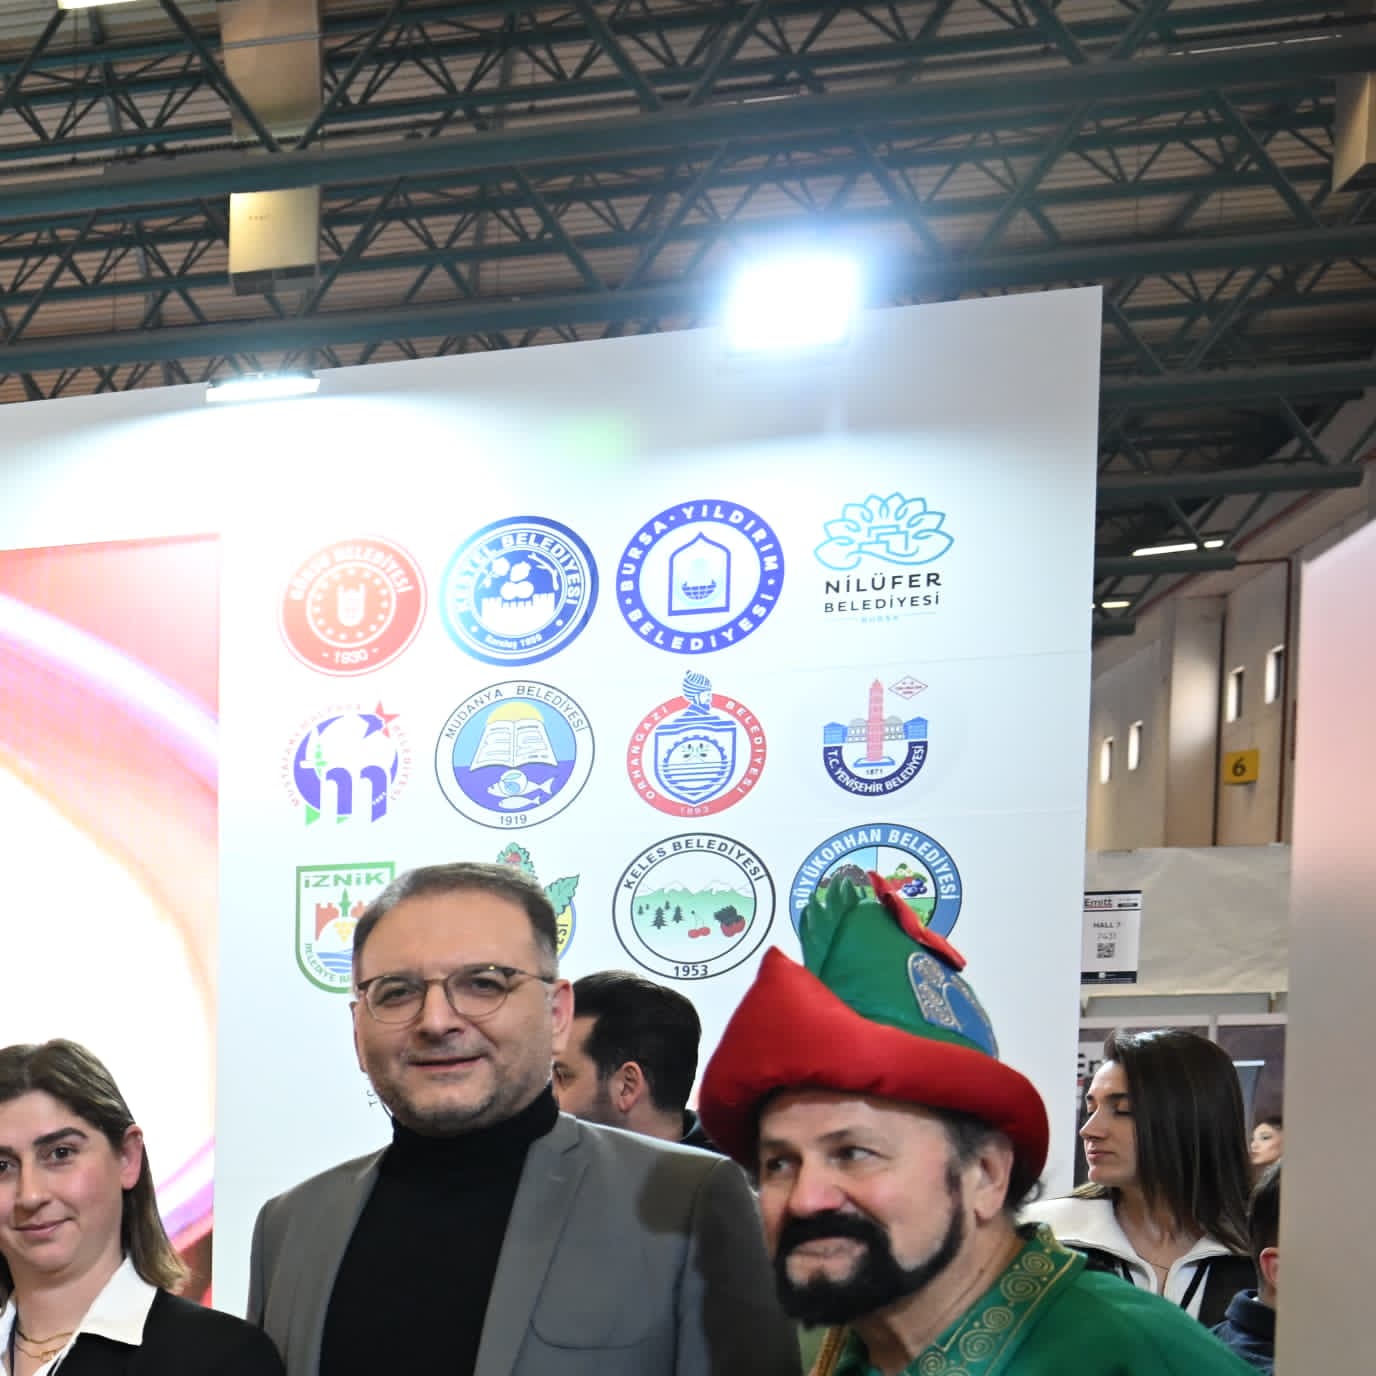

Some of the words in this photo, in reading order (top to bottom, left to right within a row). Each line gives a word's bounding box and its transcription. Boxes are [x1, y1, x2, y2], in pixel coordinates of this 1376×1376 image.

[620, 520, 668, 592] BURSA
[682, 504, 779, 572] YILDIRIM
[824, 571, 943, 595] NİLÜFER
[824, 593, 940, 614] BELEDİYESİ
[445, 688, 504, 740] MUDANYA
[516, 684, 588, 734] BELEDİYESİ
[1232, 758, 1246, 777] 6
[499, 814, 528, 827] 1919
[622, 846, 667, 891] KELES
[672, 837, 764, 882] BELEDİYESİ
[887, 829, 957, 901] BELEDİYESİ
[673, 964, 709, 978] 1953
